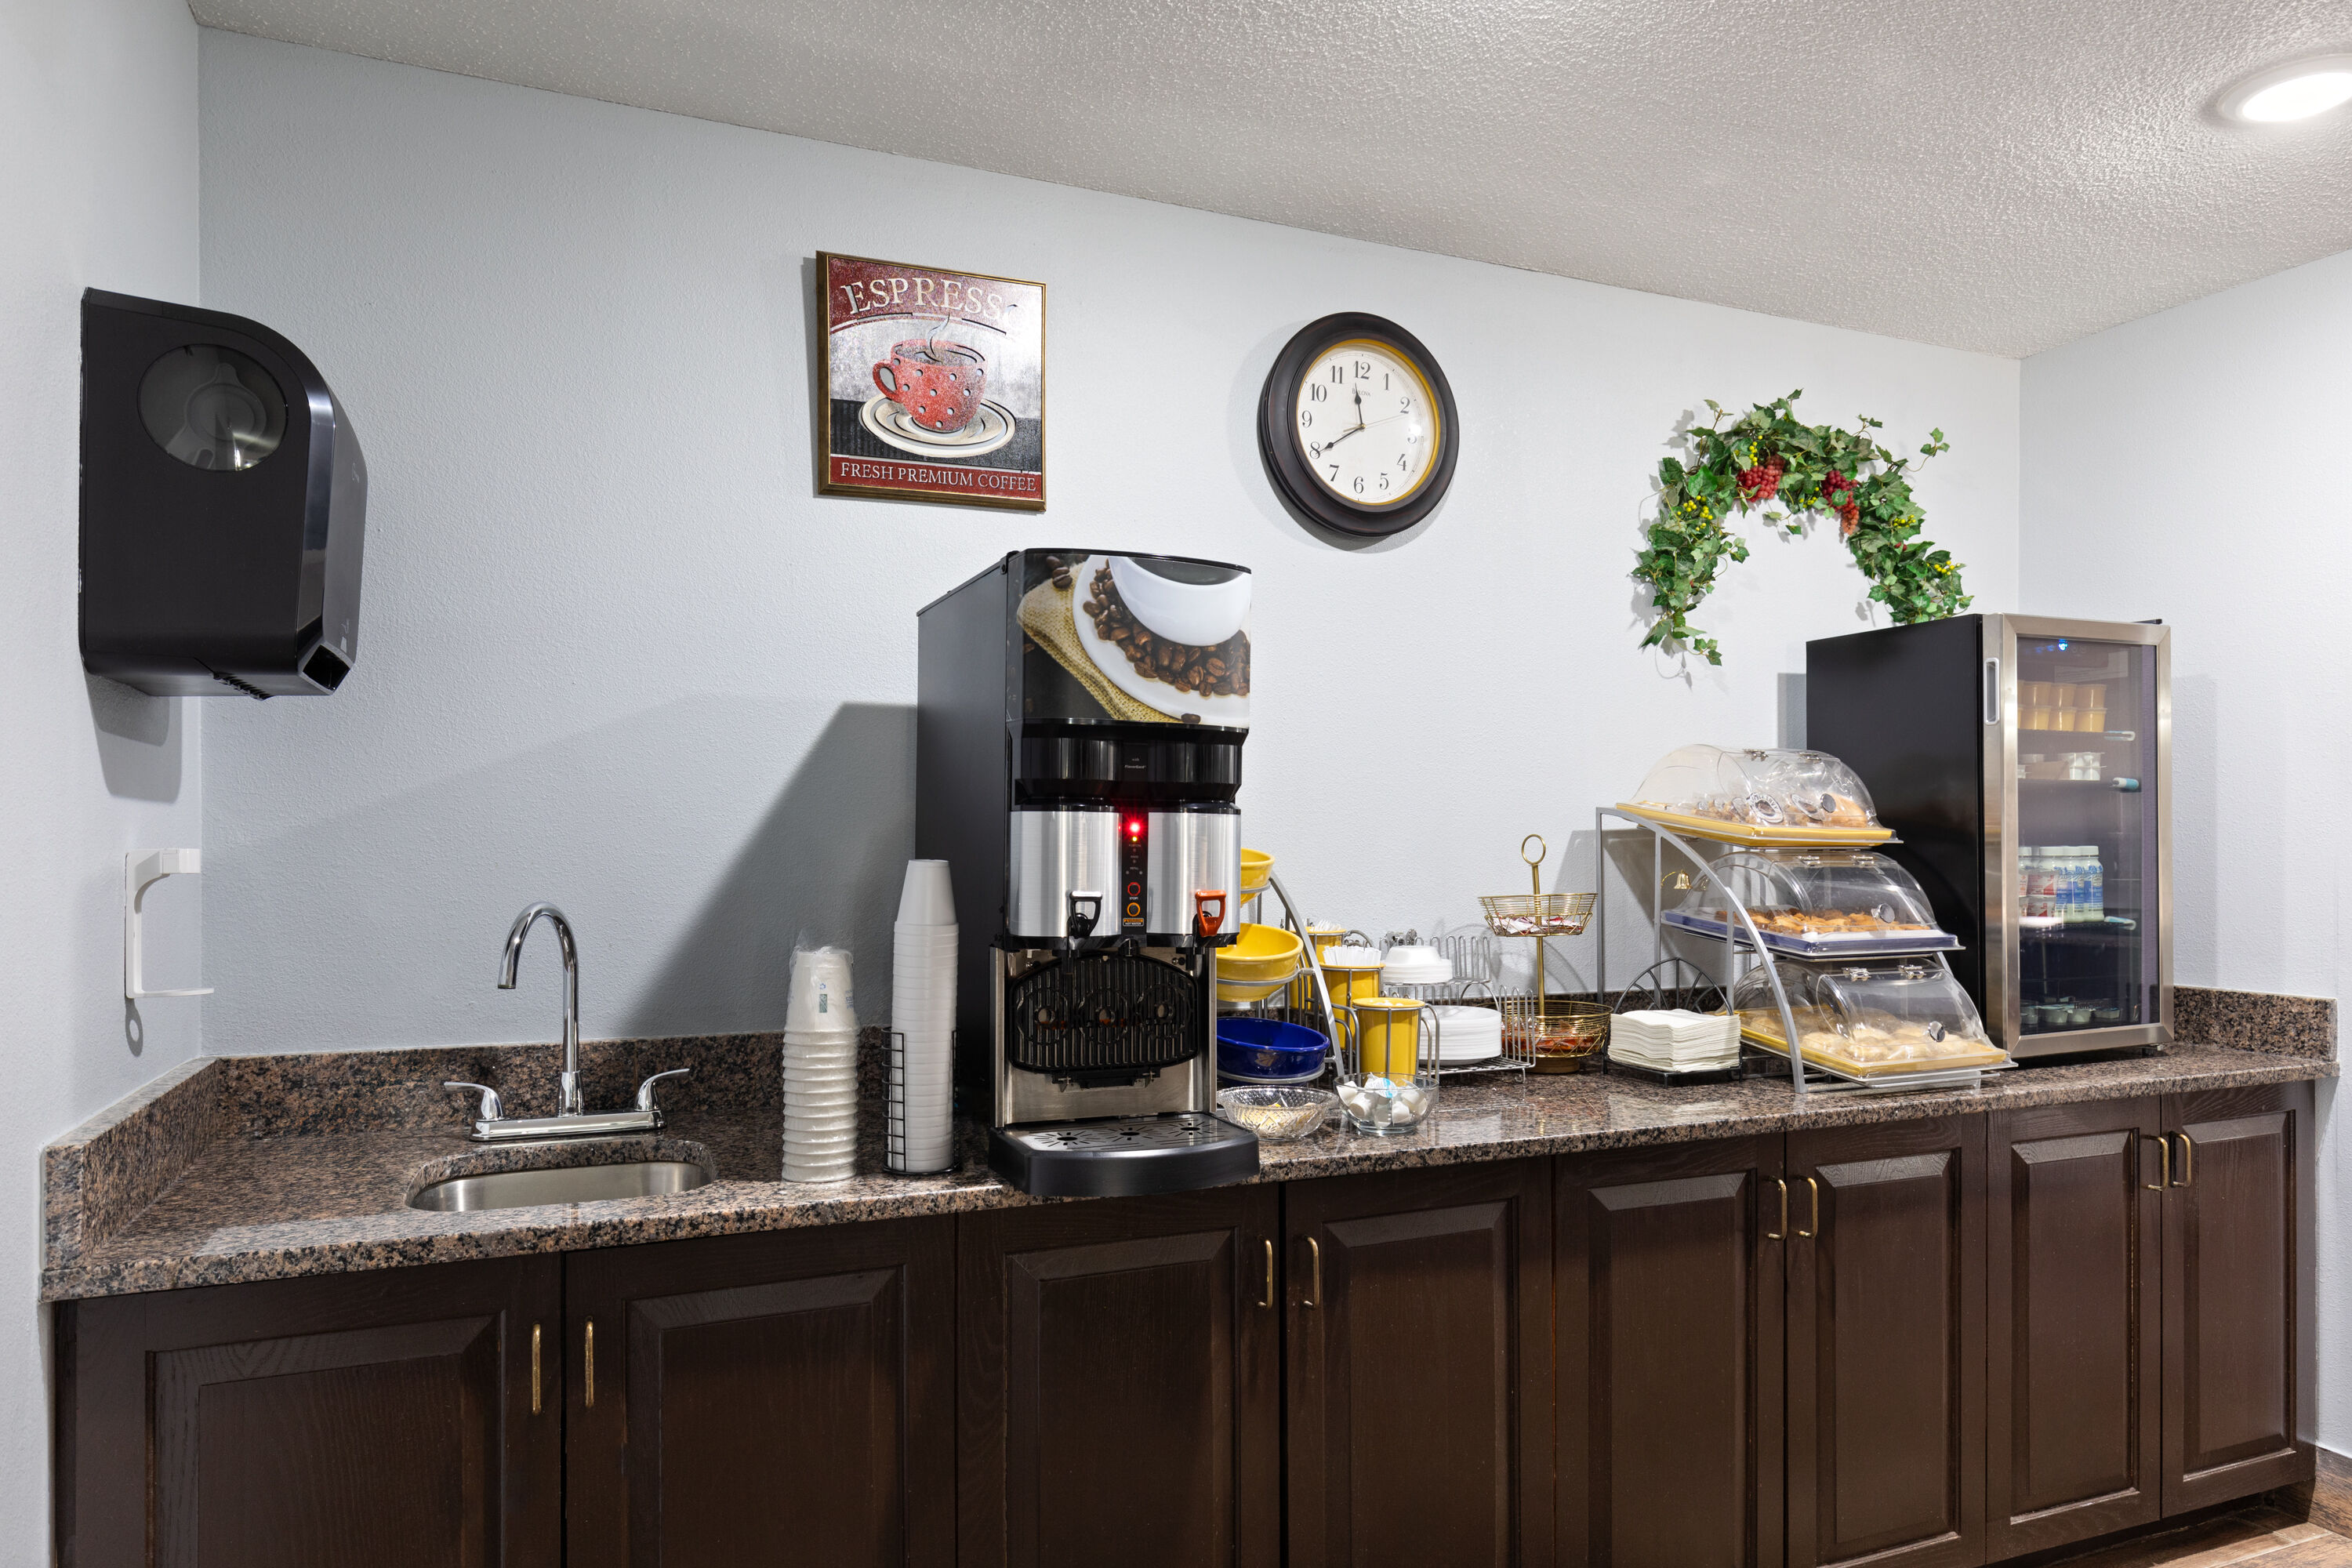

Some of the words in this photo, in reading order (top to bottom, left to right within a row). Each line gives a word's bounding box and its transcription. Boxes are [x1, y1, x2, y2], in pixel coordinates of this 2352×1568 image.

[1330, 365, 1343, 384] 11
[1352, 361, 1371, 379] 12
[1382, 373, 1389, 390] 1
[1309, 383, 1327, 402] 10
[1399, 396, 1410, 414] 2
[1301, 410, 1312, 427] 9
[1309, 441, 1321, 459] 8
[1396, 453, 1406, 471] 4
[840, 462, 894, 481] FRESH
[898, 467, 974, 487] PREMIUM
[978, 474, 1036, 492] COFFEE
[1329, 464, 1340, 481] 7
[1379, 472, 1389, 490] 5
[1353, 476, 1364, 494] 6
